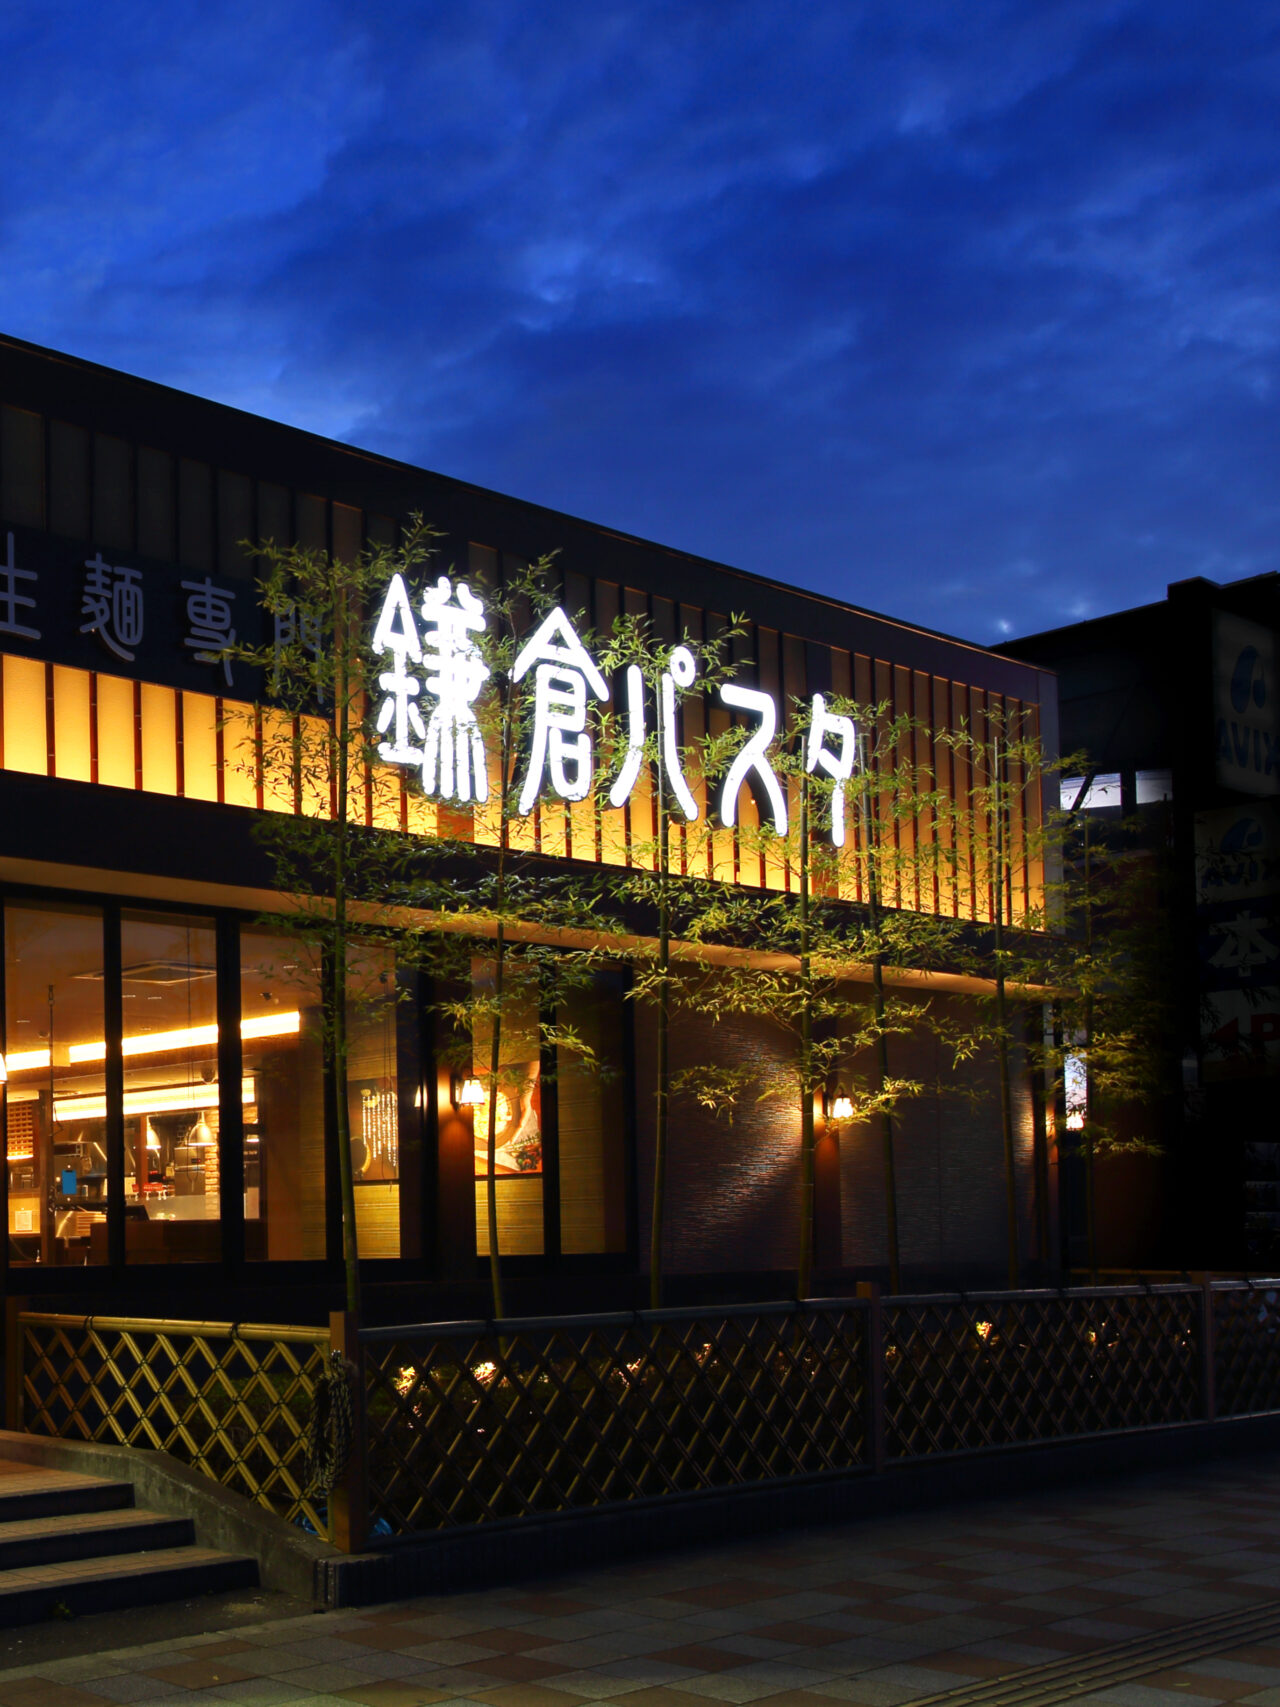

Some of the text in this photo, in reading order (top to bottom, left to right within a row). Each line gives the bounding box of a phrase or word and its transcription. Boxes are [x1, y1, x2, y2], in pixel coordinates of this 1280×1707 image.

[372, 573, 856, 847] 鎌倉パスタ
